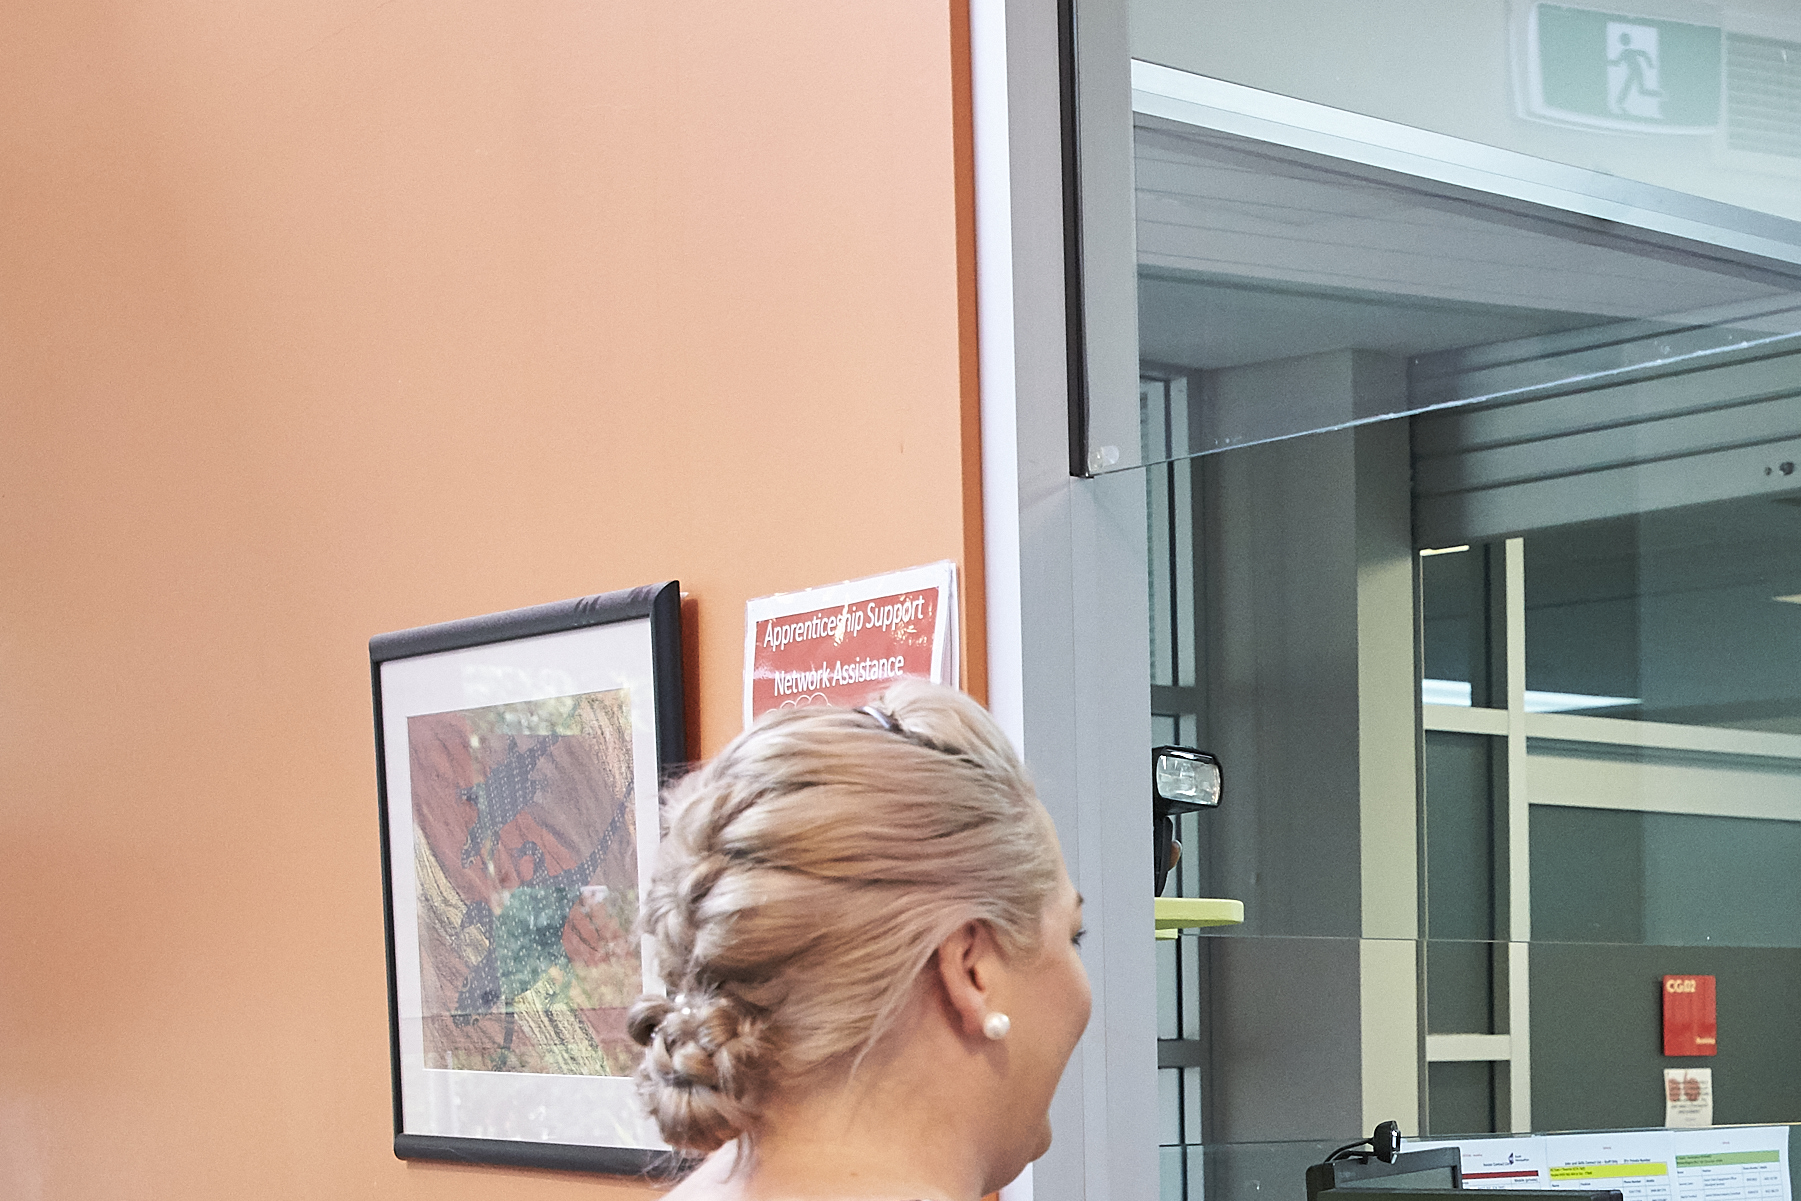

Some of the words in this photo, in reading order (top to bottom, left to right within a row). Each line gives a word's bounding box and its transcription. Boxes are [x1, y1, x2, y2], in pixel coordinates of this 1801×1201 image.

[764, 607, 864, 651] Apprenticeship
[866, 595, 925, 632] Support
[774, 662, 831, 696] Network
[833, 655, 904, 686] Assistance
